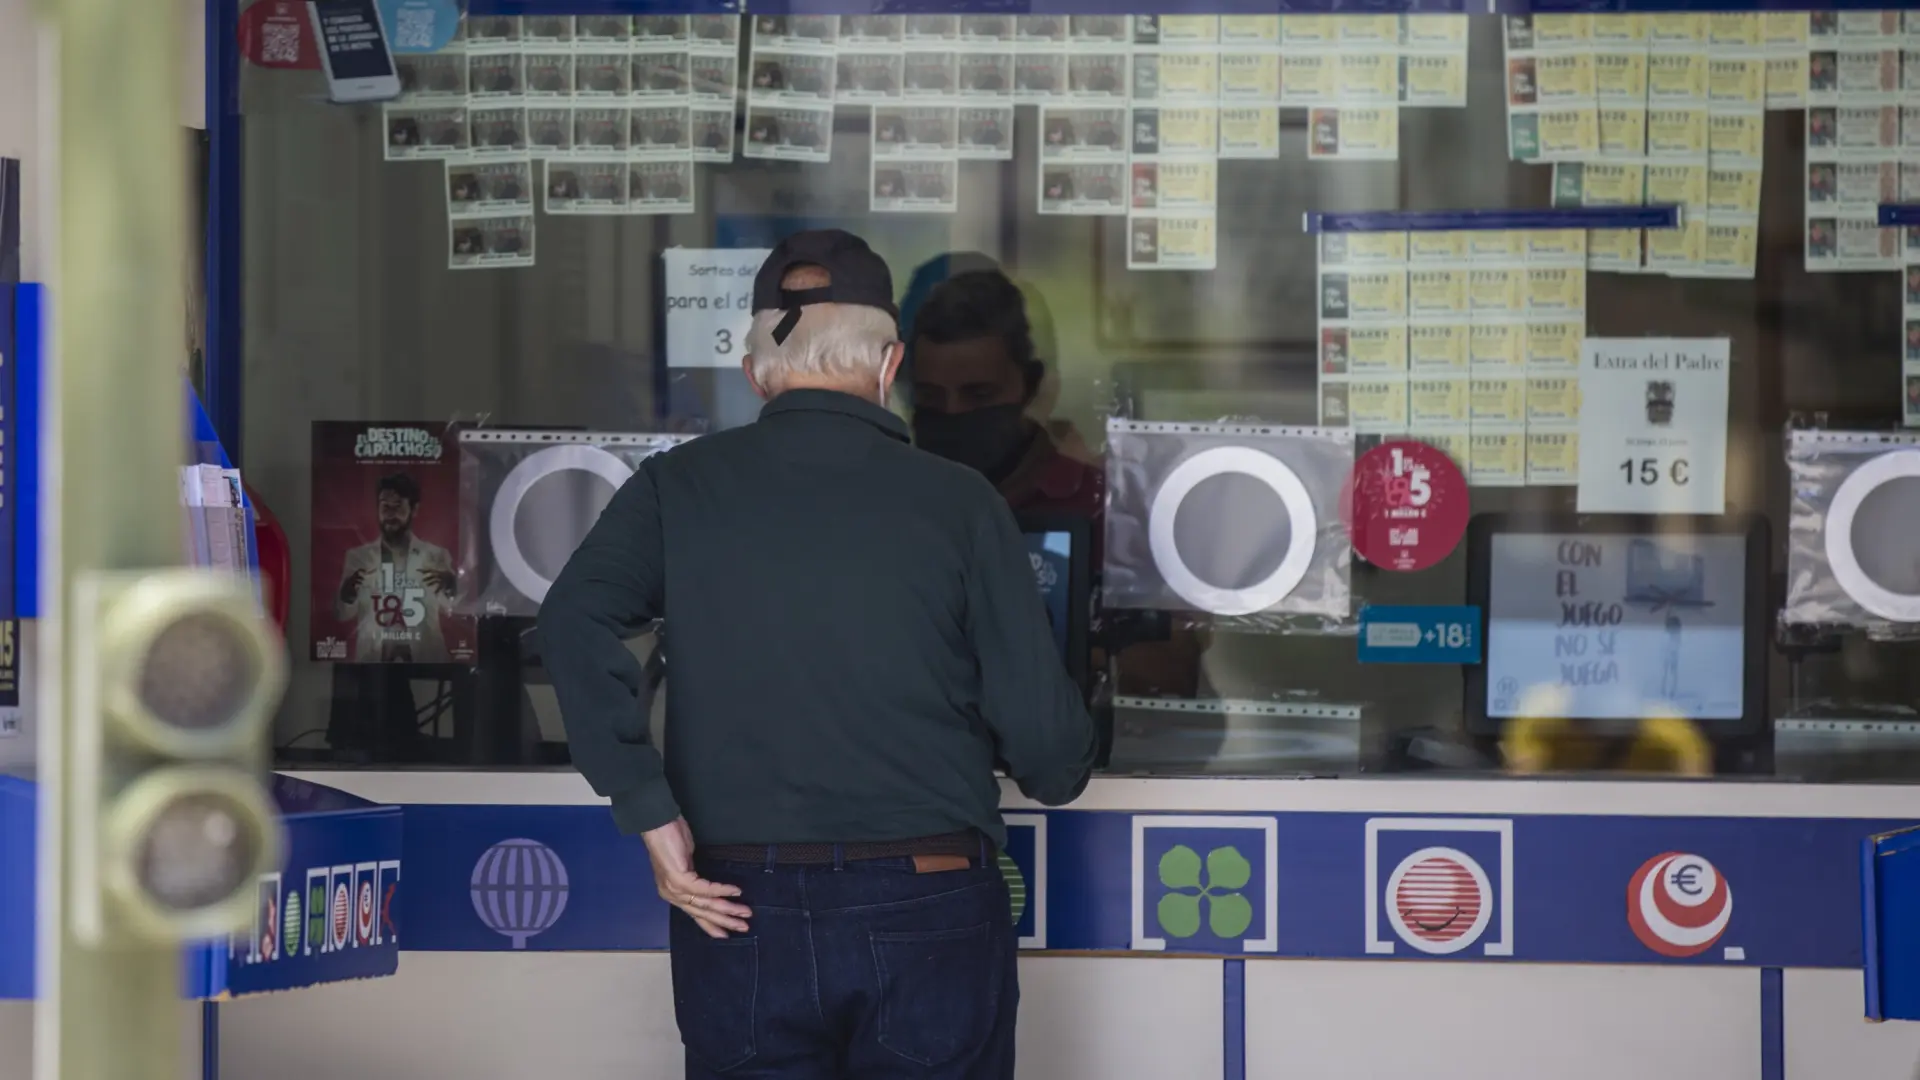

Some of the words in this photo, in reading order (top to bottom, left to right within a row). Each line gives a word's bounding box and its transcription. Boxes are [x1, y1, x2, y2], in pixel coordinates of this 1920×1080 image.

[689, 264, 735, 277] Sorteo
[666, 296, 708, 316] para
[713, 292, 731, 310] el
[1594, 352, 1637, 370] Extra
[1643, 352, 1669, 370] del
[1675, 352, 1723, 371] Padre
[367, 427, 429, 443] DESTINO
[1620, 458, 1659, 486] 15
[1557, 540, 1602, 567] CON
[1555, 569, 1579, 598] EL
[1557, 602, 1624, 629] JUEGO
[1423, 622, 1465, 648] +18
[1554, 634, 1588, 657] NO
